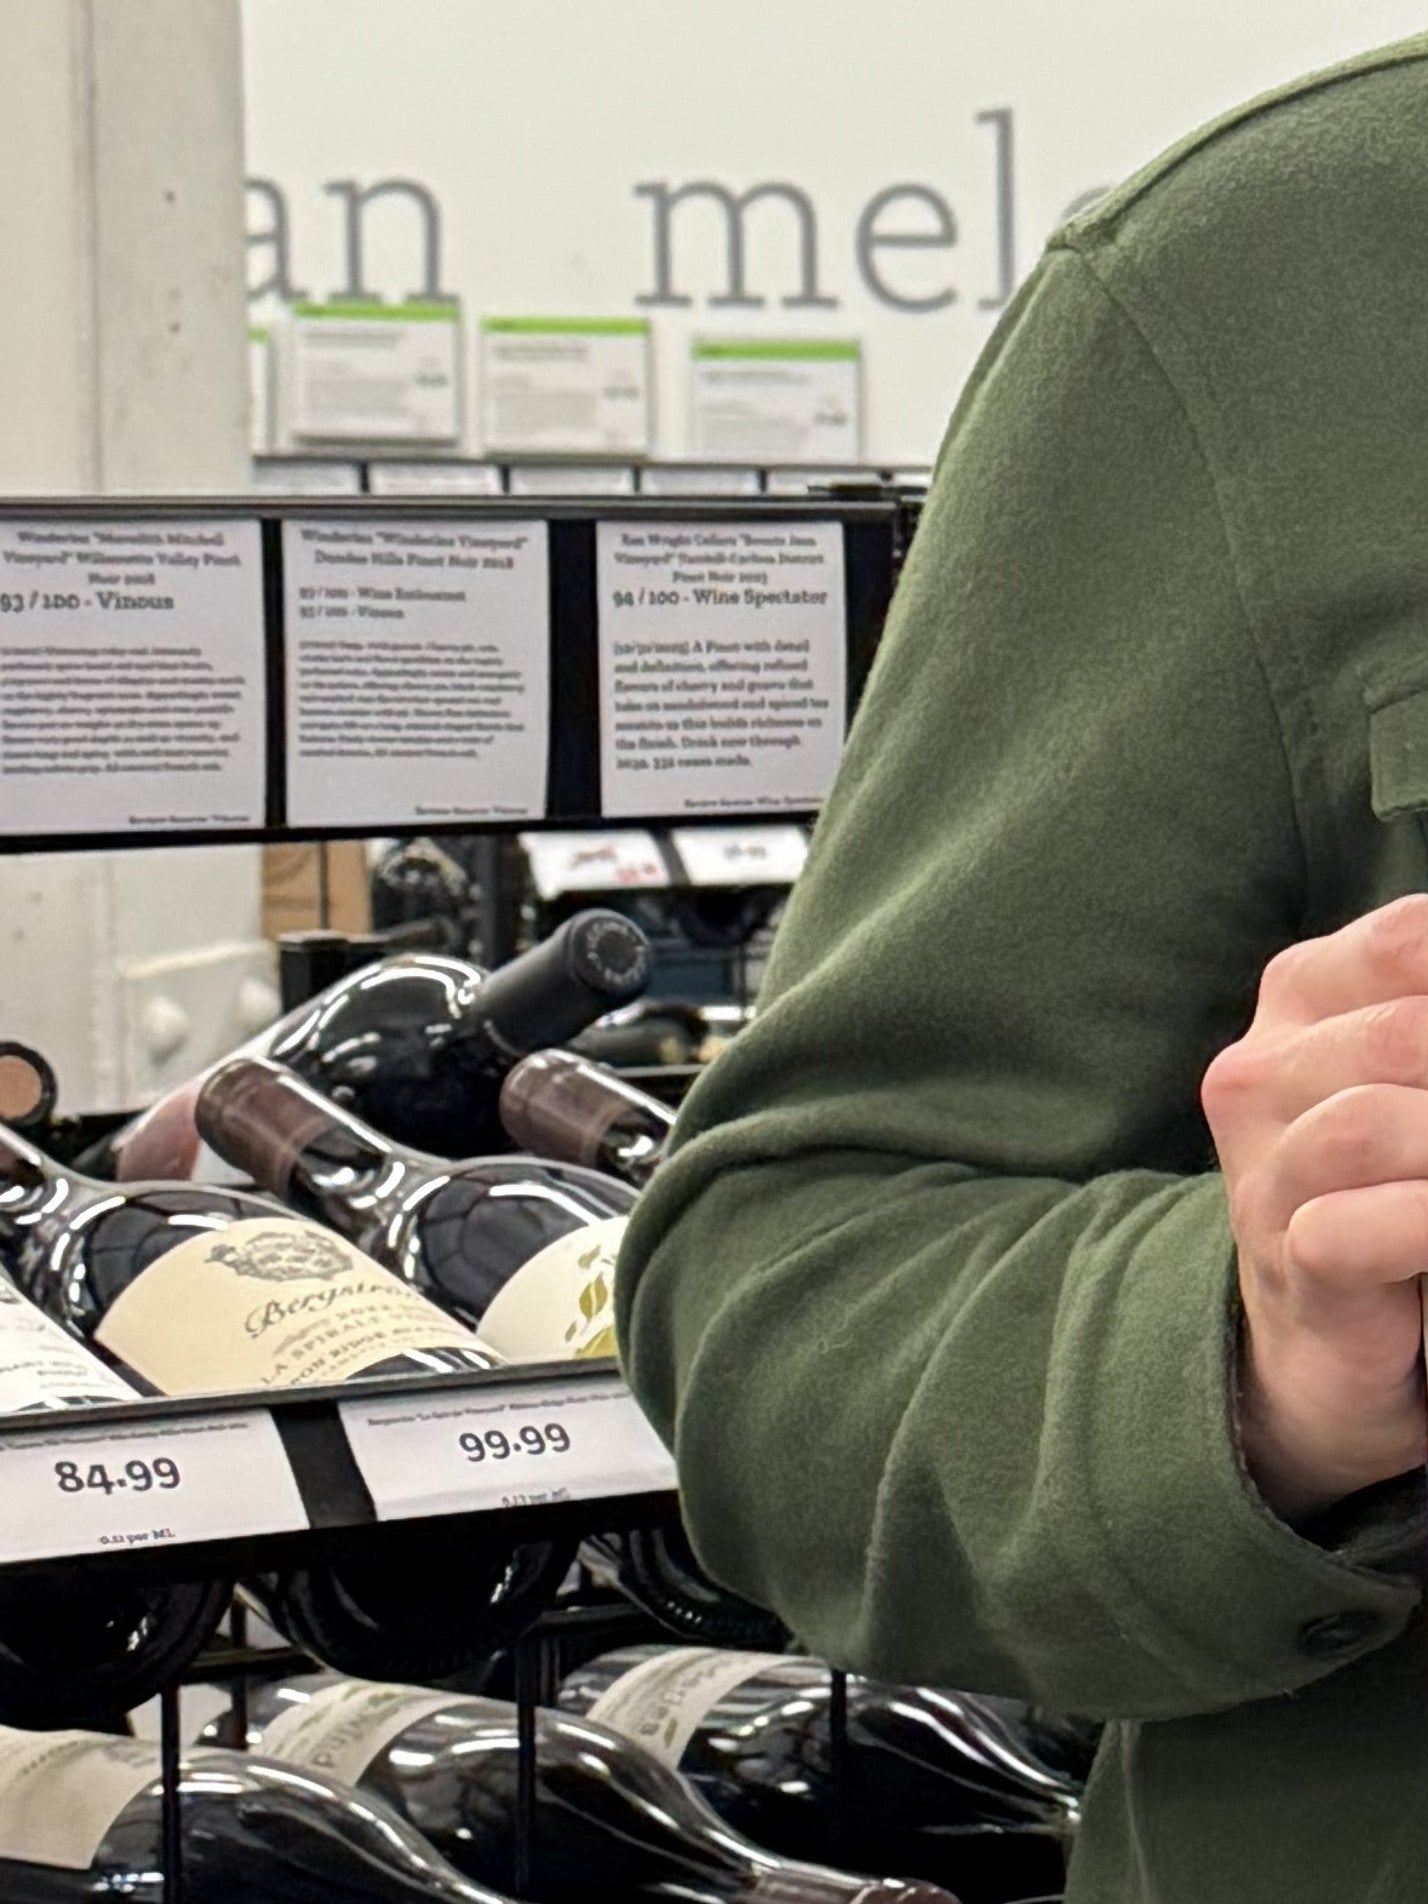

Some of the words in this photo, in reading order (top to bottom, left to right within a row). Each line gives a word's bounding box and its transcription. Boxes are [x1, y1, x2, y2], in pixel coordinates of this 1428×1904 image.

[633, 107, 1112, 311] mel
[95, 591, 175, 610] Vinous
[649, 592, 680, 606] 100
[692, 589, 740, 605] Wine
[743, 589, 829, 610] Spectator
[458, 1422, 572, 1463] 99.99
[53, 1456, 182, 1496] 84.99
